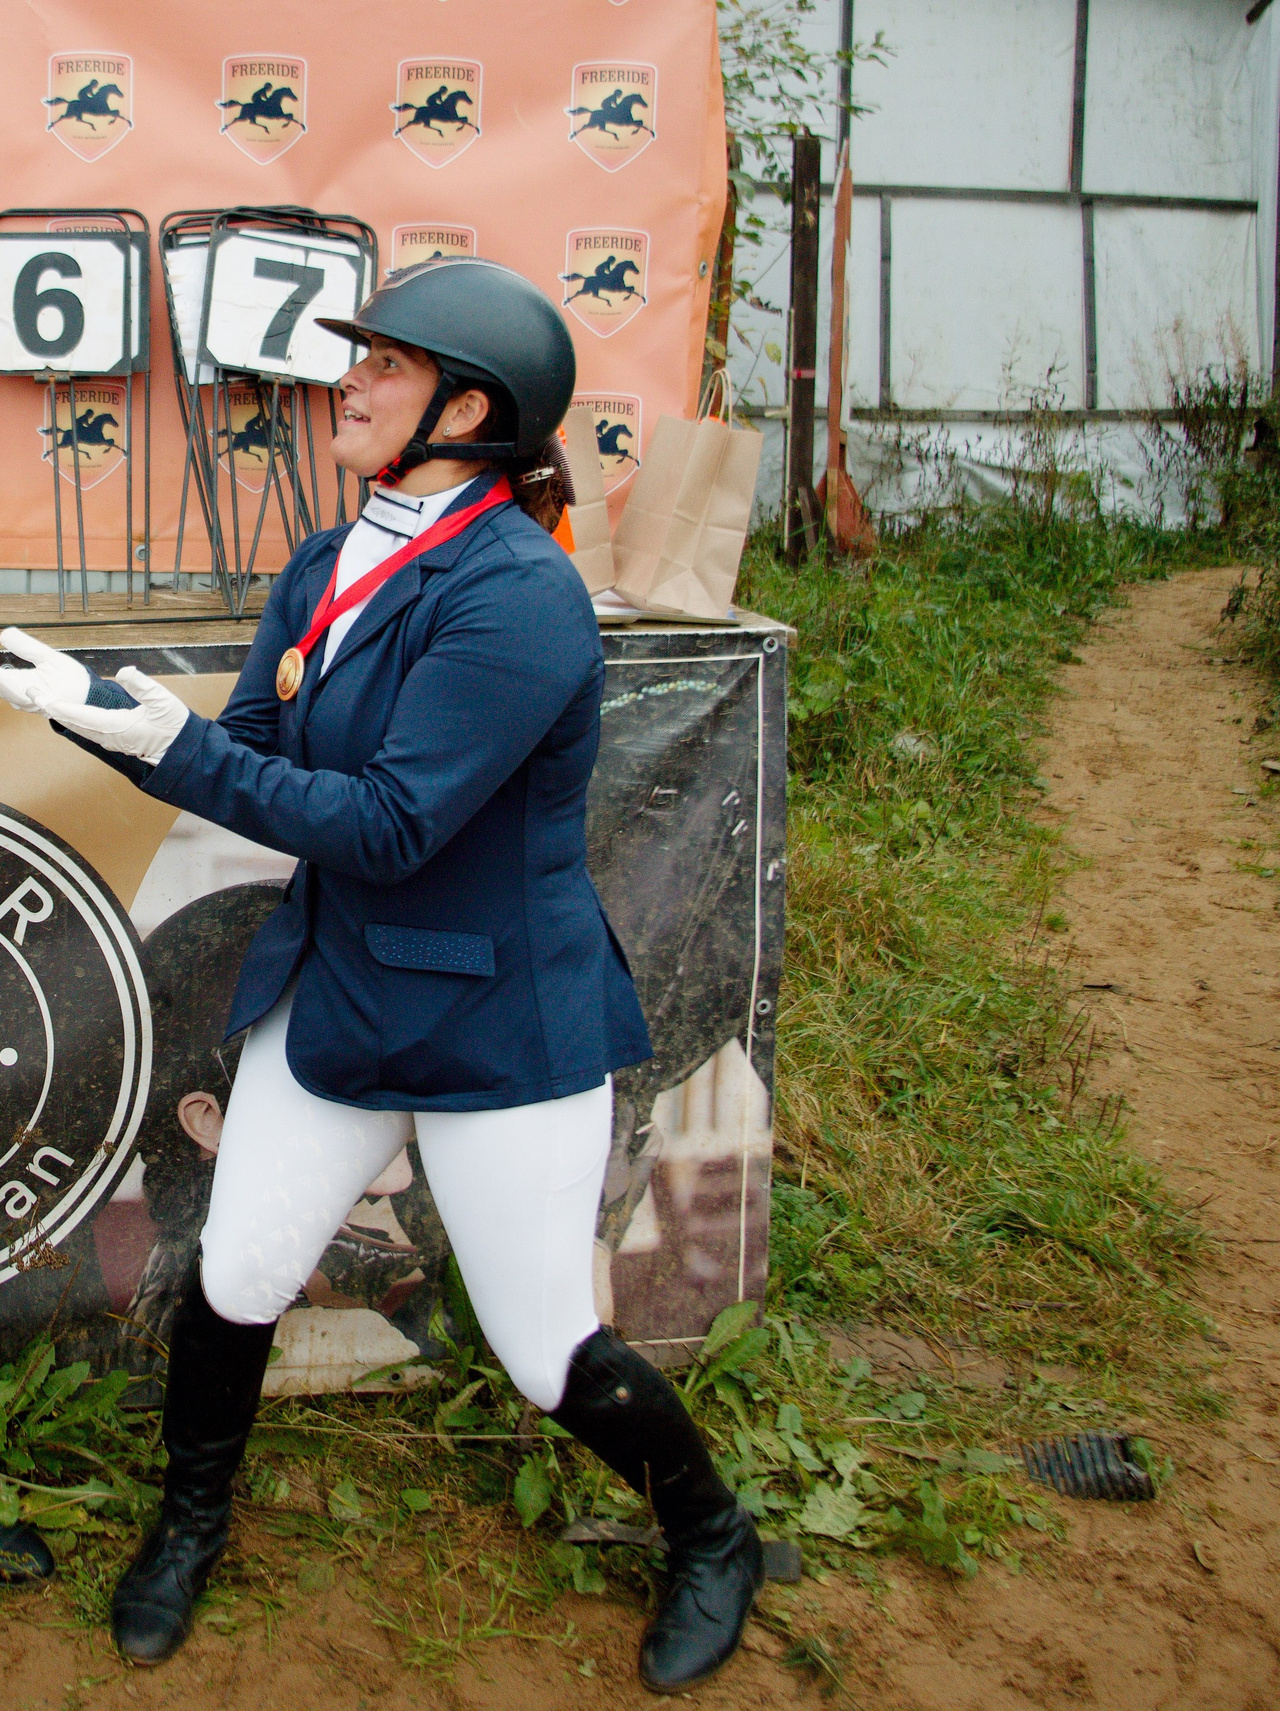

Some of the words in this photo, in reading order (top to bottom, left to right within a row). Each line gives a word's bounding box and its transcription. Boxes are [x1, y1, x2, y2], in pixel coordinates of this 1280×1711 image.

[58, 60, 124, 76] FREERIDE
[232, 63, 298, 79] FREERIDE
[407, 66, 474, 82] FREERIDE
[581, 70, 649, 85] FREERIDE
[401, 232, 468, 248] FREERIDE
[576, 236, 641, 252] FREERIDE
[13, 251, 84, 359] 6
[253, 257, 325, 362] 7
